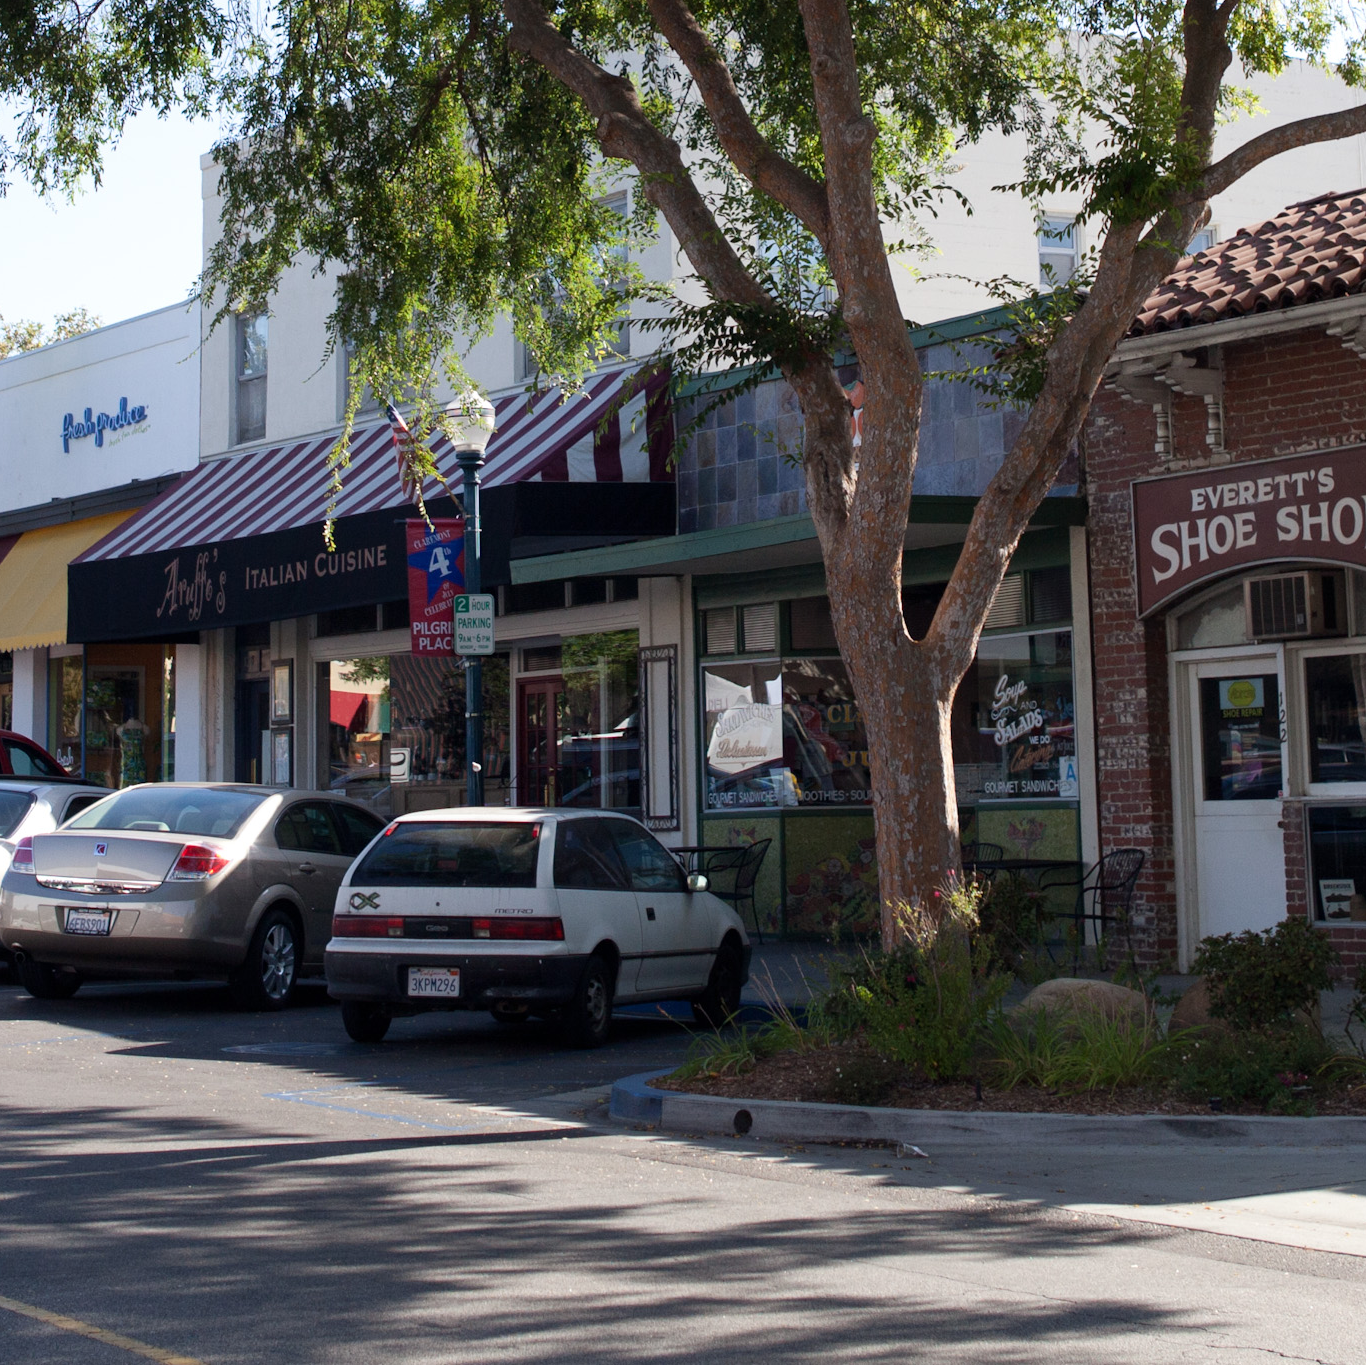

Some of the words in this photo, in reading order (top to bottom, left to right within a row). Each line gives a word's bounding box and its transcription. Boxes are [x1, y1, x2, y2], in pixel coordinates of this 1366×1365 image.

[60, 412, 96, 453] fresh
[95, 396, 148, 447] produce
[1190, 466, 1335, 512] EVERETT'S
[414, 529, 451, 549] CLAREMONT
[1150, 511, 1258, 585] SHOE
[245, 560, 308, 590] ITALIAN
[314, 545, 387, 578] CUISINE
[458, 598, 467, 611] 2
[472, 602, 490, 611] HOUR
[413, 622, 453, 635] PILGRI
[458, 618, 491, 629] PARKING
[992, 674, 1028, 707] Soup
[1019, 700, 1037, 710] AND
[1223, 709, 1240, 719] SHOE
[1240, 708, 1263, 717] REPAIR
[716, 703, 776, 738] SANDWICHES
[994, 708, 1043, 745] SALADS
[1029, 736, 1039, 744] WE
[1040, 735, 1050, 744] DO
[1066, 763, 1076, 782] A
[984, 781, 1018, 794] GOURMET
[708, 791, 737, 805] GOURMET
[411, 977, 456, 994] 3KPM296
